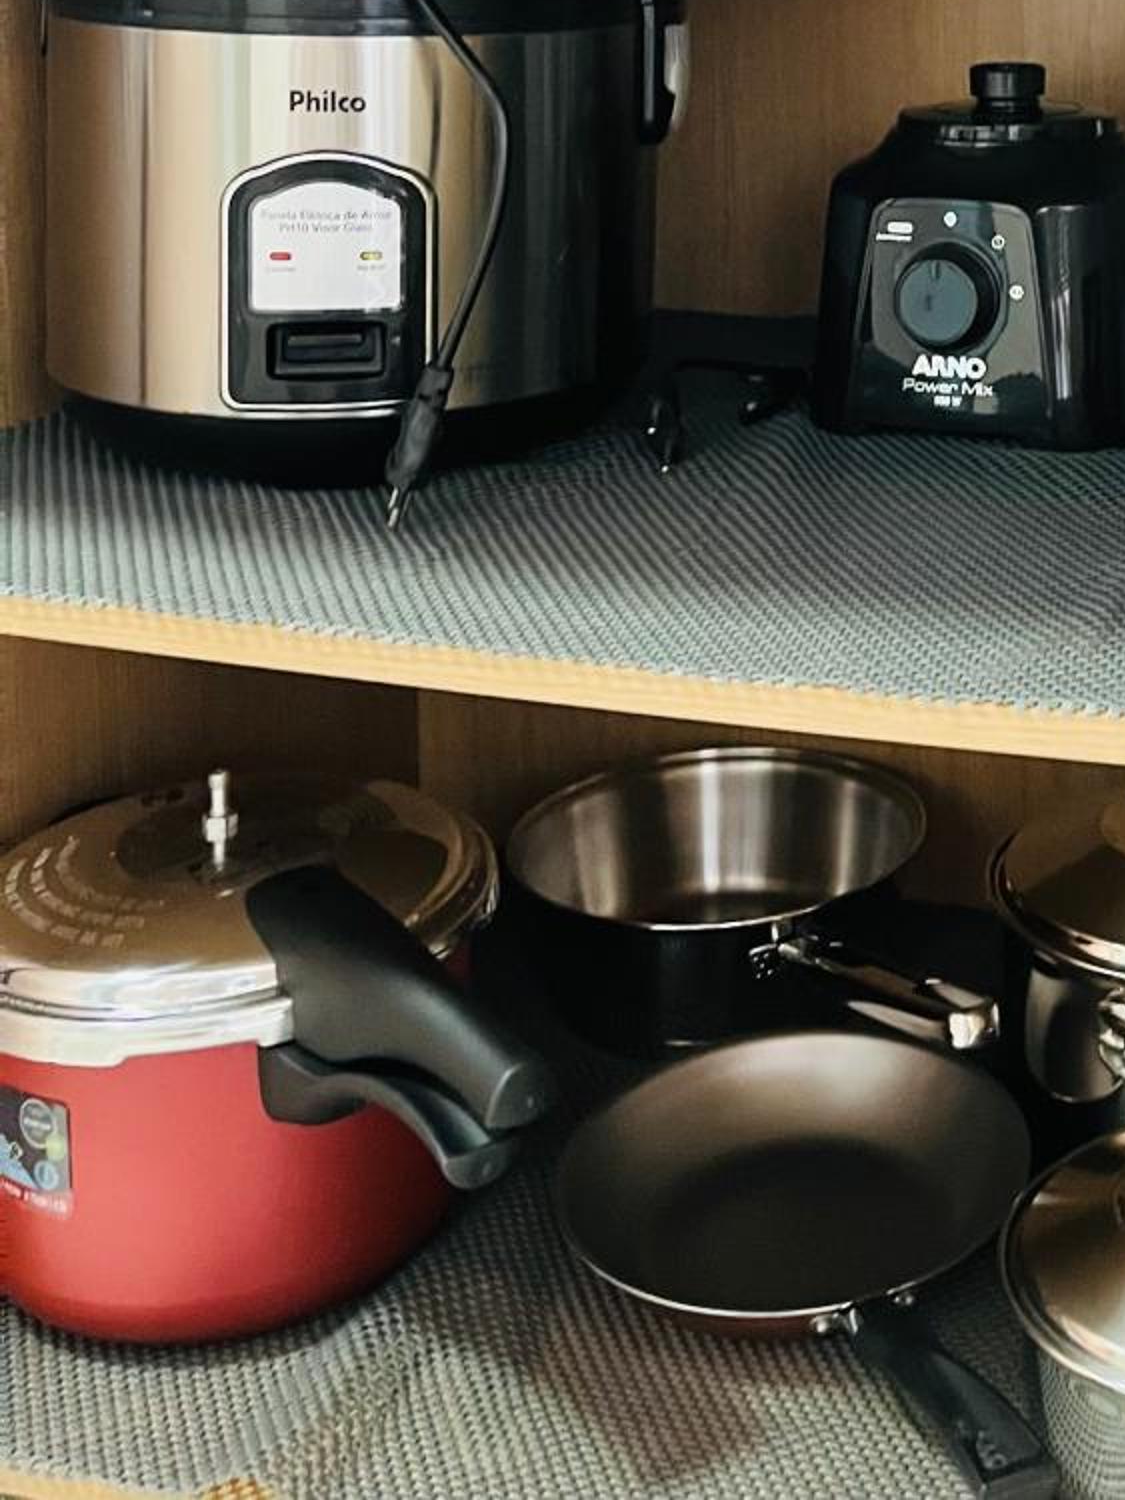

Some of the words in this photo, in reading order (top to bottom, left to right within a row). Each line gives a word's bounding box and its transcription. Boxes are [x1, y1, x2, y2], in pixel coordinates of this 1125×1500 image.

[289, 89, 367, 113] Philco
[912, 354, 987, 379] ARNO
[902, 377, 959, 394] Power
[961, 381, 994, 397] Mix
